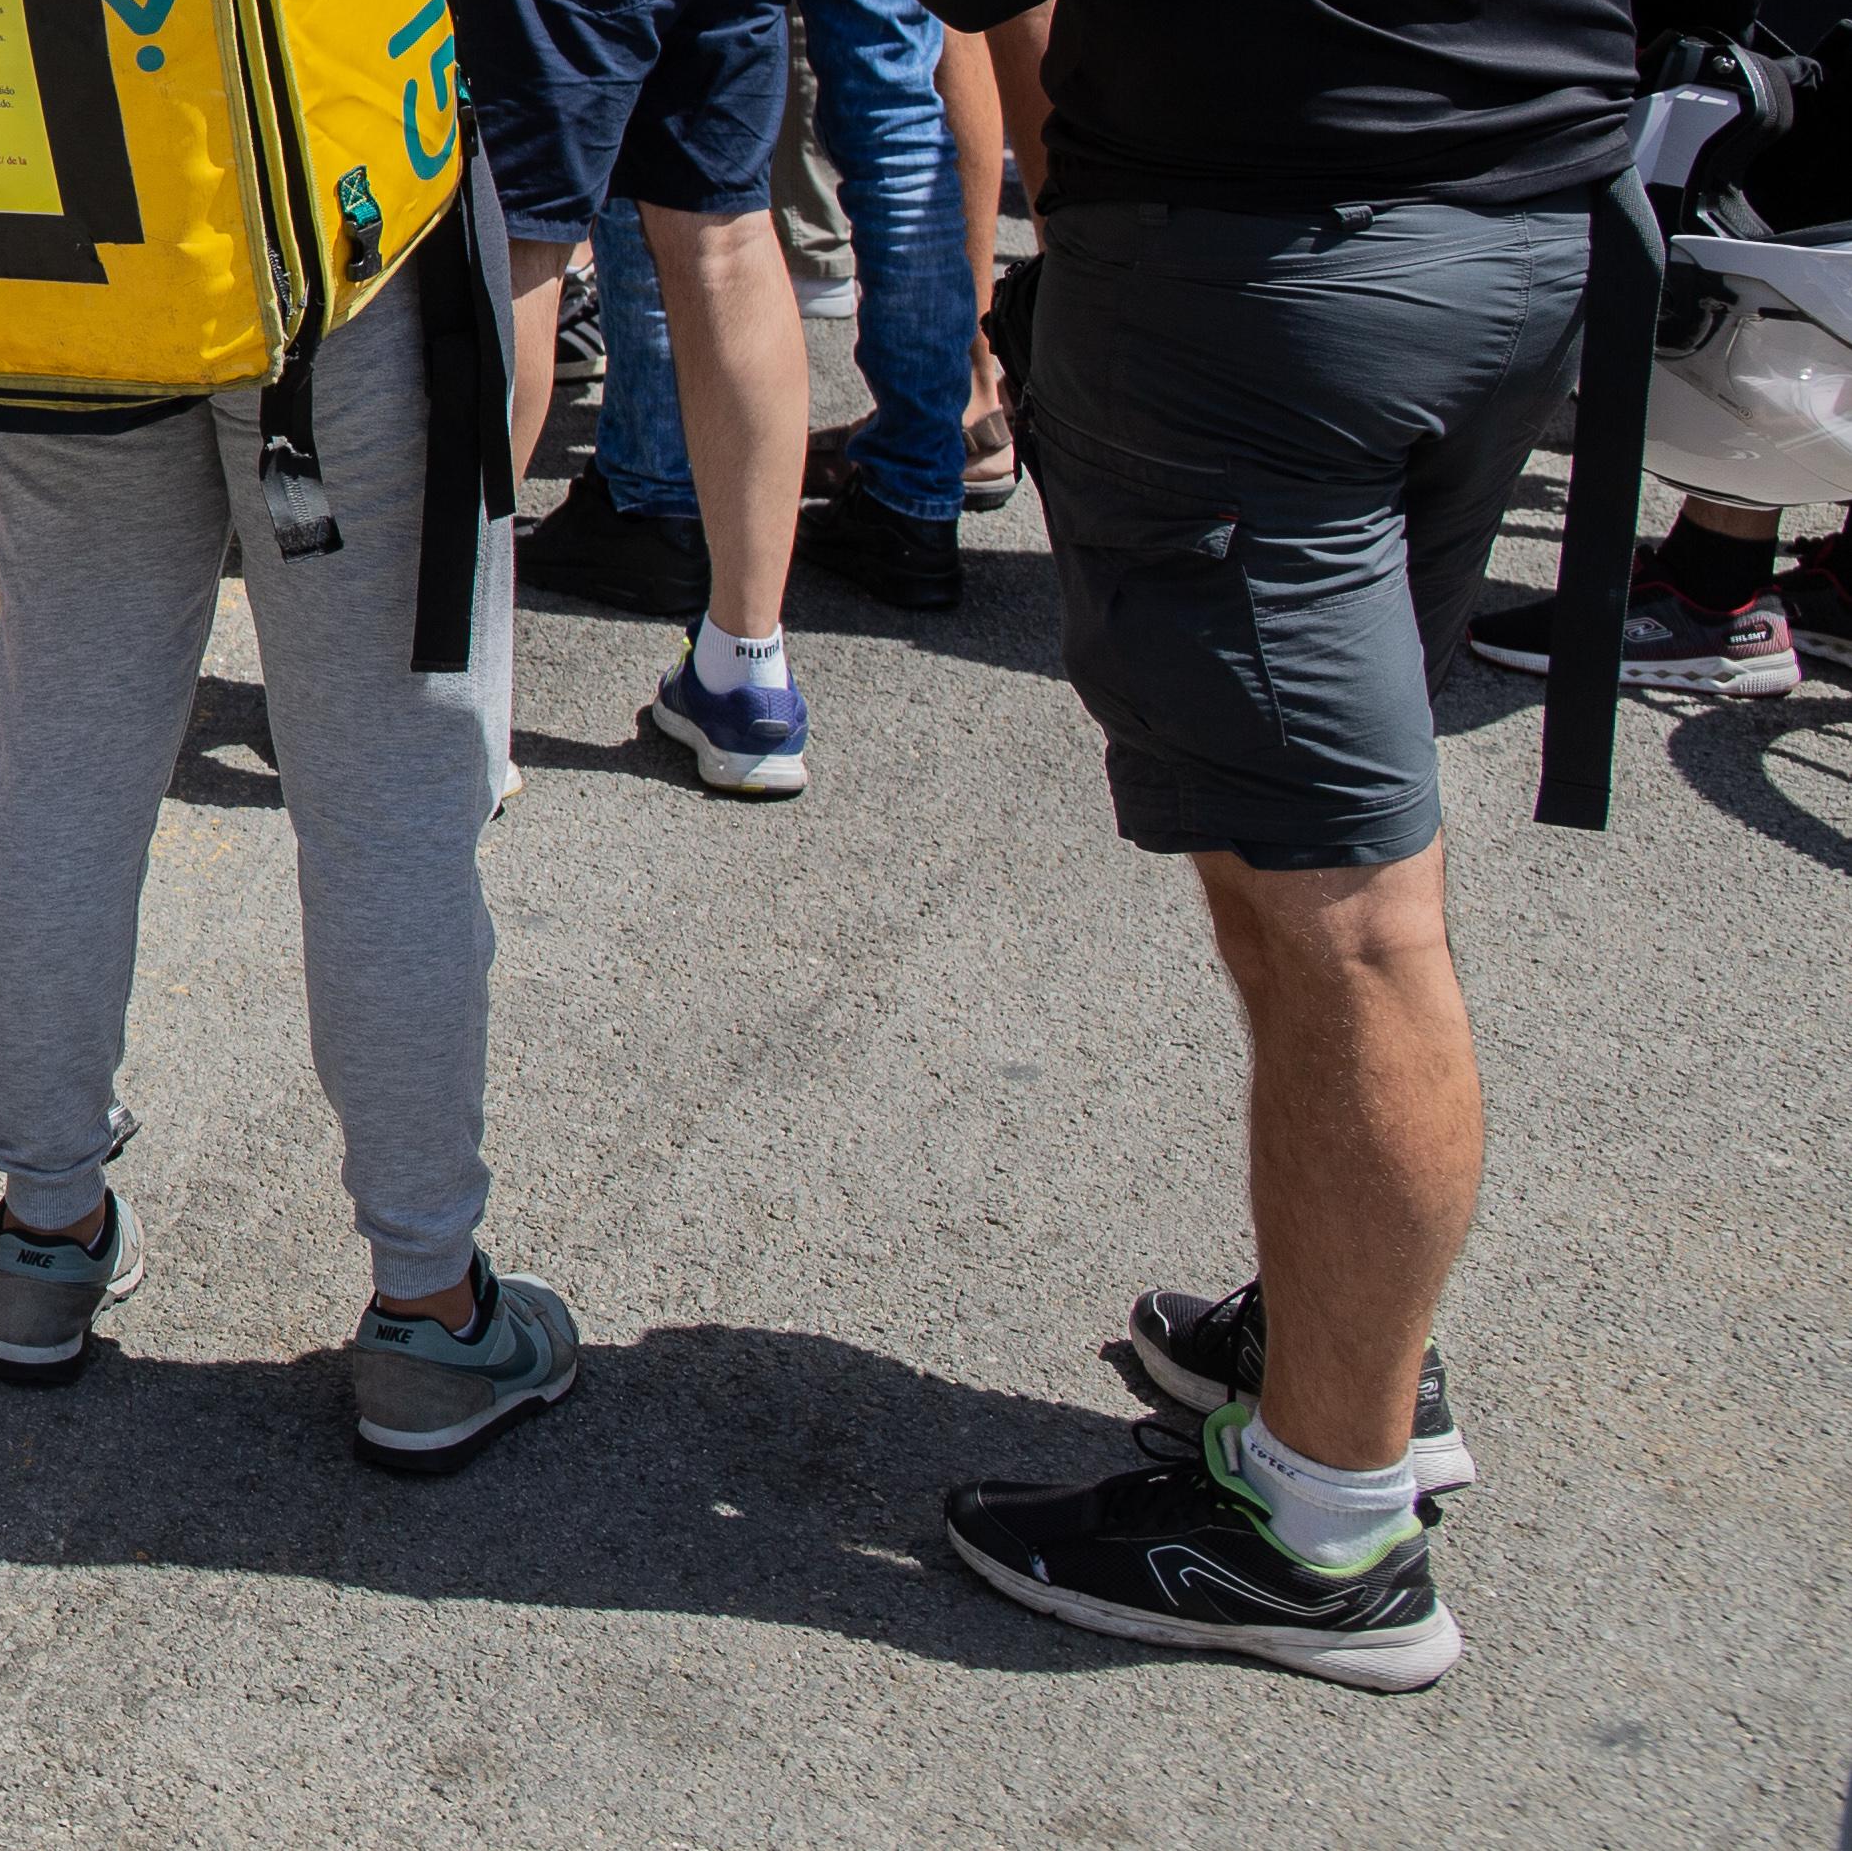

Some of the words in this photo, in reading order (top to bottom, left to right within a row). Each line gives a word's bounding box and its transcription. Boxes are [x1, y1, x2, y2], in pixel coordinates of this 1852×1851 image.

[7, 157, 17, 165] de
[19, 157, 27, 165] la
[16, 1248, 55, 1270] NIKE
[374, 1323, 413, 1345] NIKE
